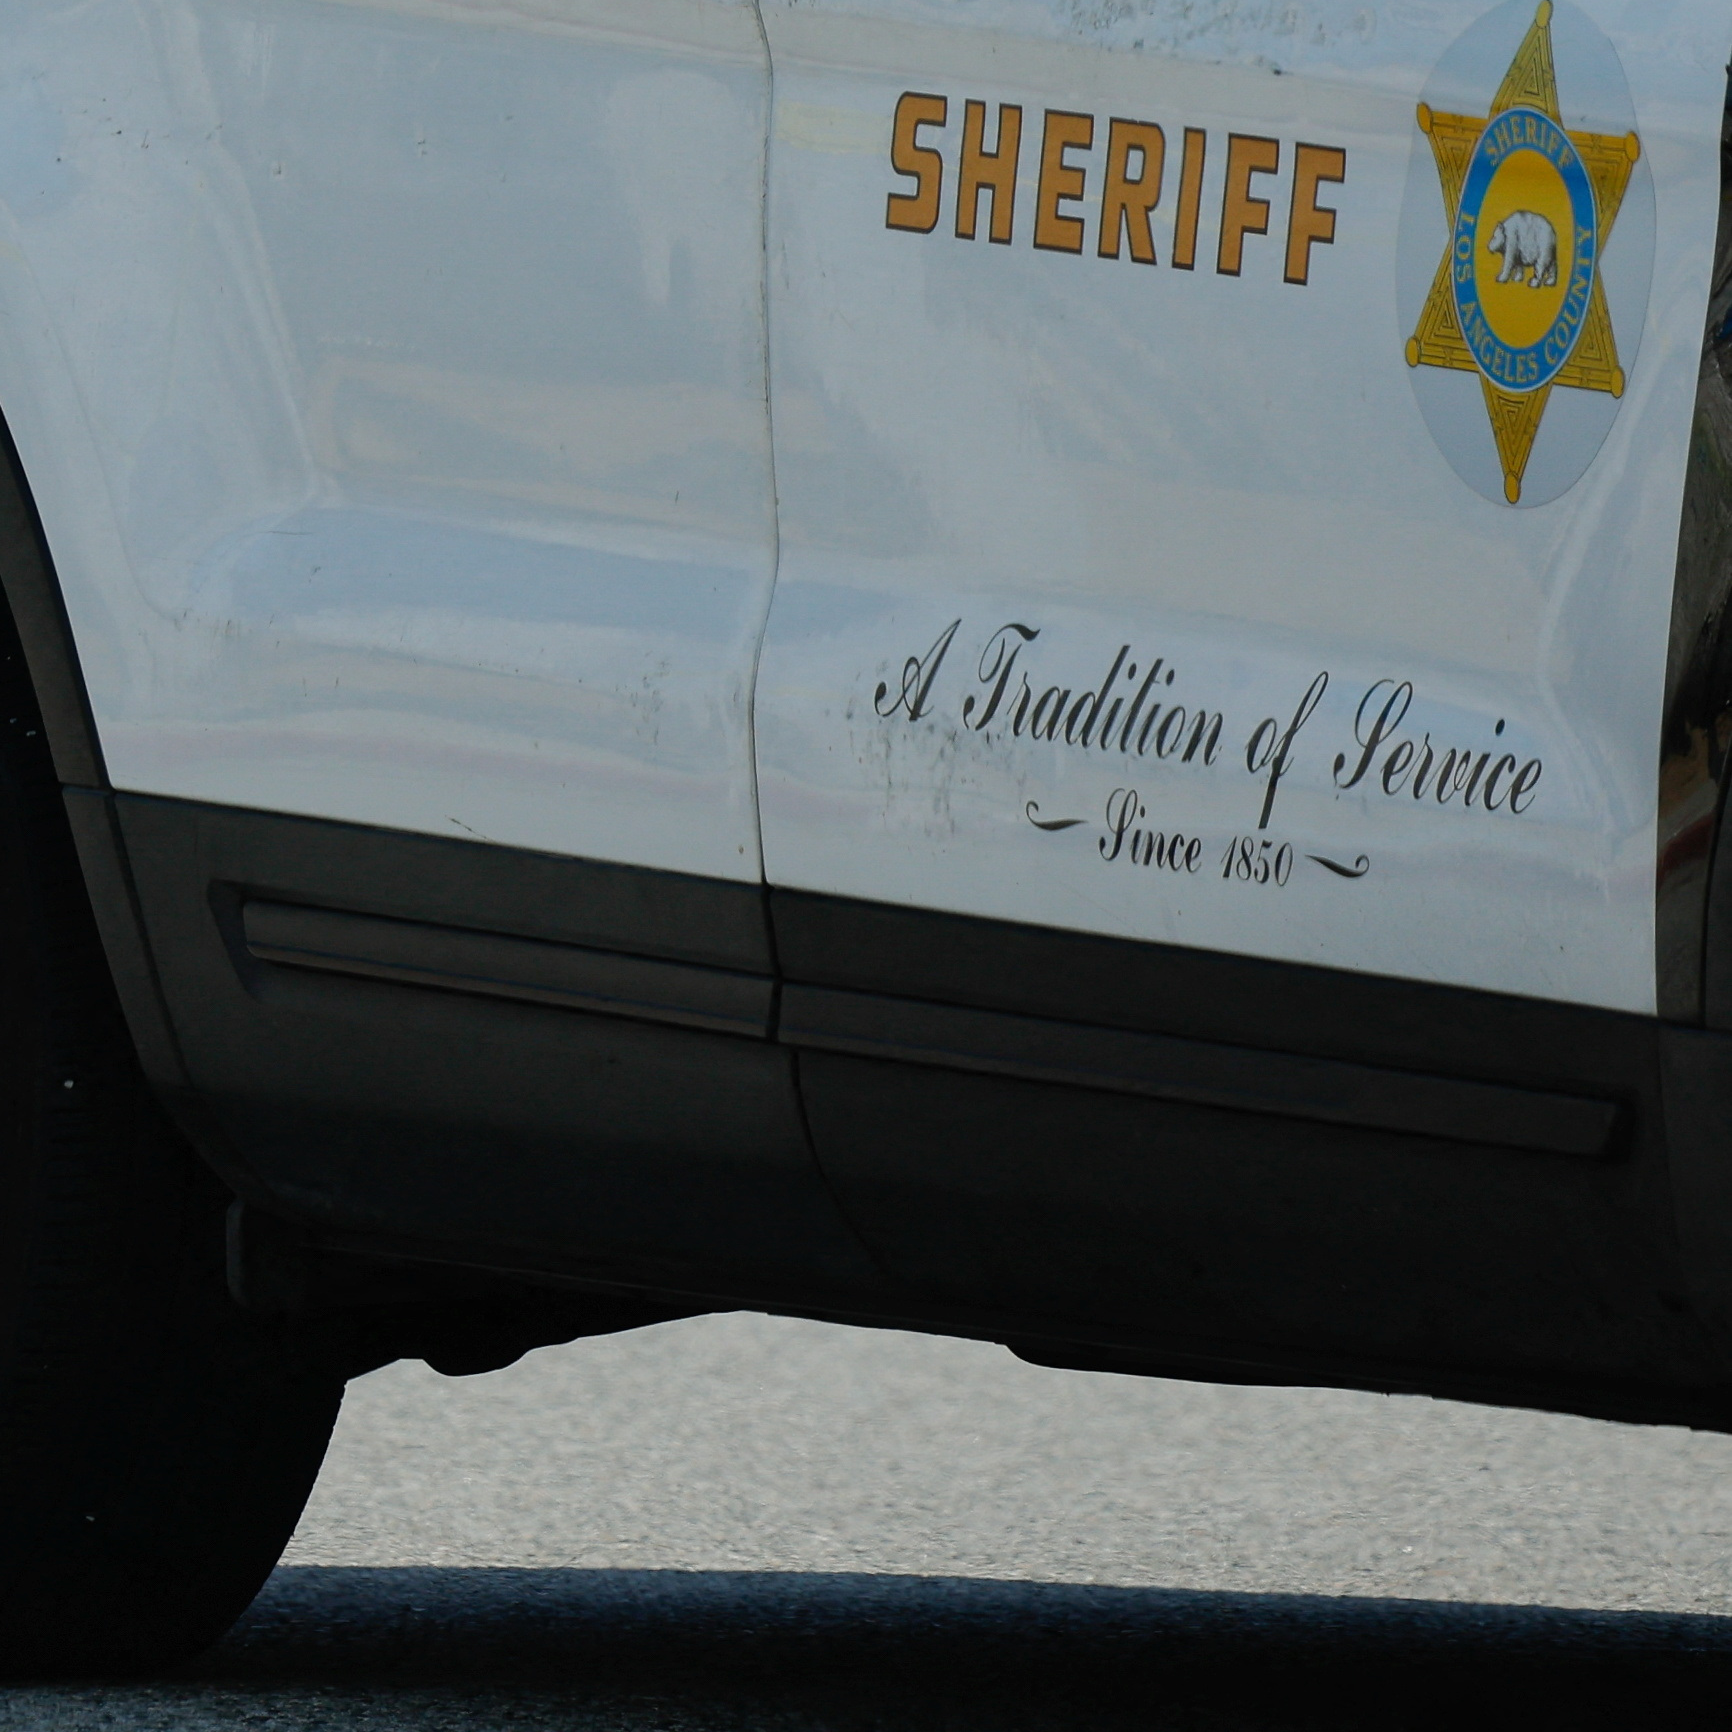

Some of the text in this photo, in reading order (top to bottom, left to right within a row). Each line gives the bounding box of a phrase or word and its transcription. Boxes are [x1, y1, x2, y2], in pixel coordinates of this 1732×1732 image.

[885, 90, 1346, 286] SHERIFF
[1485, 115, 1574, 168] SHERIFF
[1454, 210, 1592, 384] LOS ANGELES COUNTY
[874, 618, 1543, 830] A Tradition of Service
[1098, 787, 1294, 888] Since 1850
